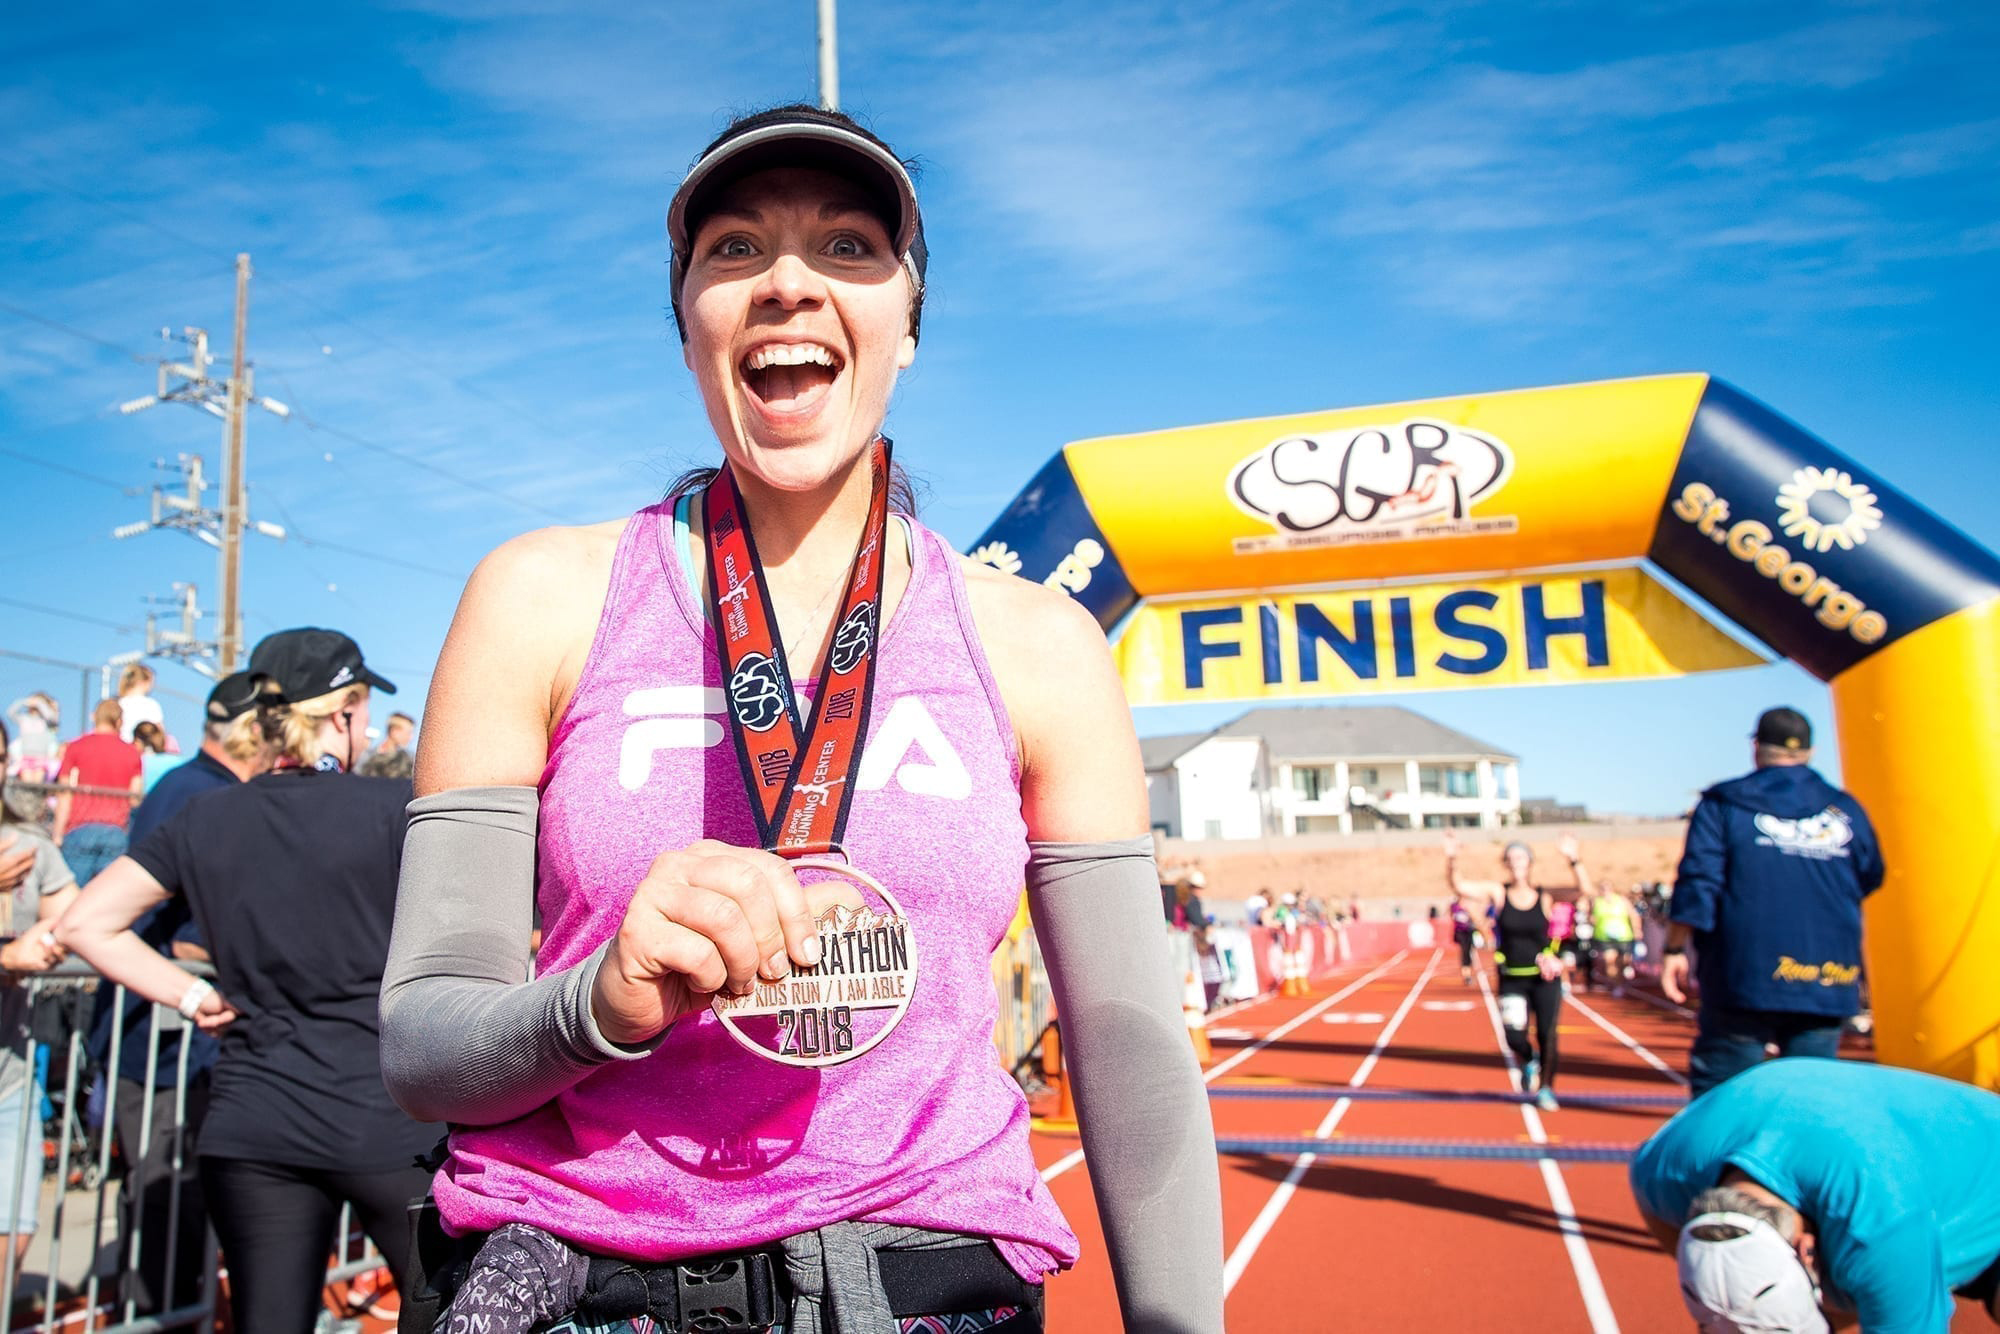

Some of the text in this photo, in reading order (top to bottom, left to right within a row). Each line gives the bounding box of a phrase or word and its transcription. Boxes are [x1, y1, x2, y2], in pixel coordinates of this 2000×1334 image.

[724, 552, 749, 639] RUNNING CENTER
[1180, 580, 1611, 690] FINISH
[824, 687, 857, 724] 2018
[618, 686, 973, 800] FA
[793, 739, 837, 848] RUNNING CENTER
[791, 925, 908, 978] RATHON
[755, 983, 787, 1007] KIDS
[792, 981, 821, 1005] RUN
[847, 978, 867, 1001] AM
[872, 976, 906, 1000] ABLE
[778, 1006, 853, 1056] 2018
